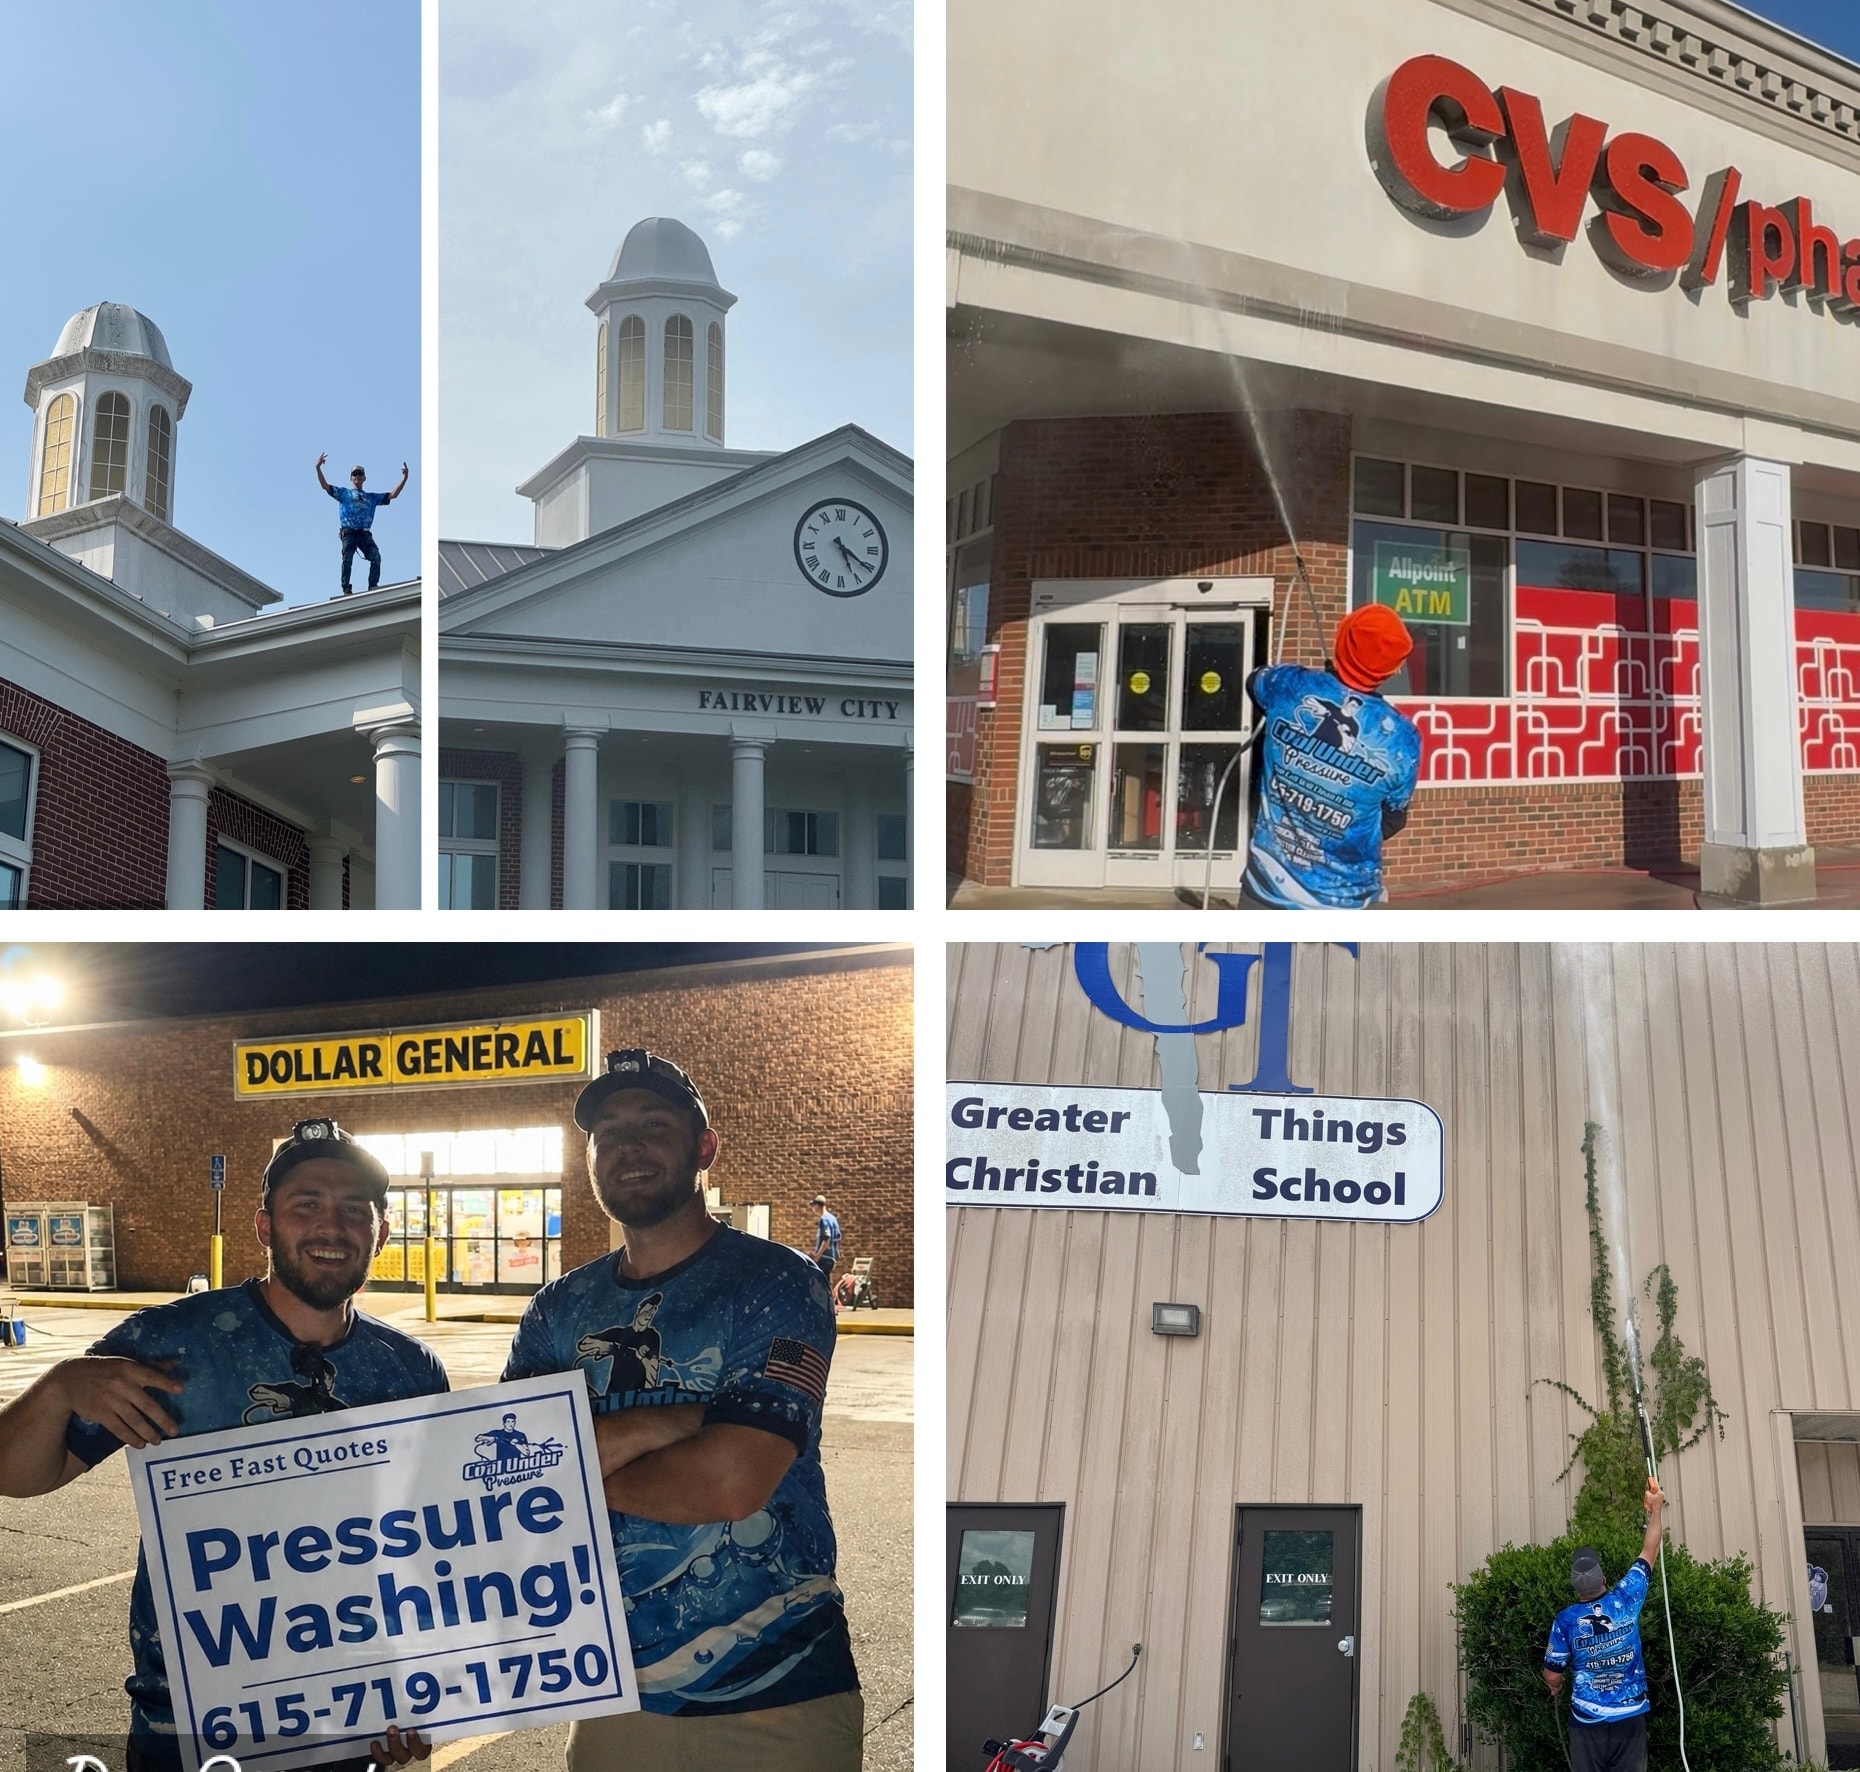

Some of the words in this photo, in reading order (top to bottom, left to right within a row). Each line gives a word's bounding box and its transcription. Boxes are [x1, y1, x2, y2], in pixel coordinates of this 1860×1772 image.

[1387, 556, 1457, 585] Allpoint
[1394, 587, 1452, 615] ATM
[698, 690, 827, 715] FAIRVIEW
[841, 699, 899, 719] CITY
[1273, 718, 1317, 755] Cool
[1312, 741, 1386, 785] Under
[1284, 746, 1351, 786] Pressure
[245, 1043, 383, 1085] DOLLAR
[397, 1028, 574, 1076] GENERAL
[951, 1097, 1131, 1134] Greater
[1252, 1108, 1407, 1154] Things
[946, 1157, 1157, 1196] Christian
[1252, 1168, 1406, 1206] School
[161, 1469, 222, 1491] Free
[229, 1457, 287, 1478] Fast
[293, 1438, 388, 1472] Quotes
[463, 1460, 503, 1481] Cool
[505, 1449, 563, 1475] Under
[483, 1468, 544, 1491] Pressure
[185, 1486, 565, 1592] Pressure
[960, 1574, 991, 1585] EXIT
[993, 1574, 1026, 1585] ONLY
[1266, 1573, 1294, 1584] EXIT
[1297, 1573, 1328, 1584] ONLY
[183, 1544, 597, 1668] Washing!
[201, 1643, 610, 1750] 615-719-1750
